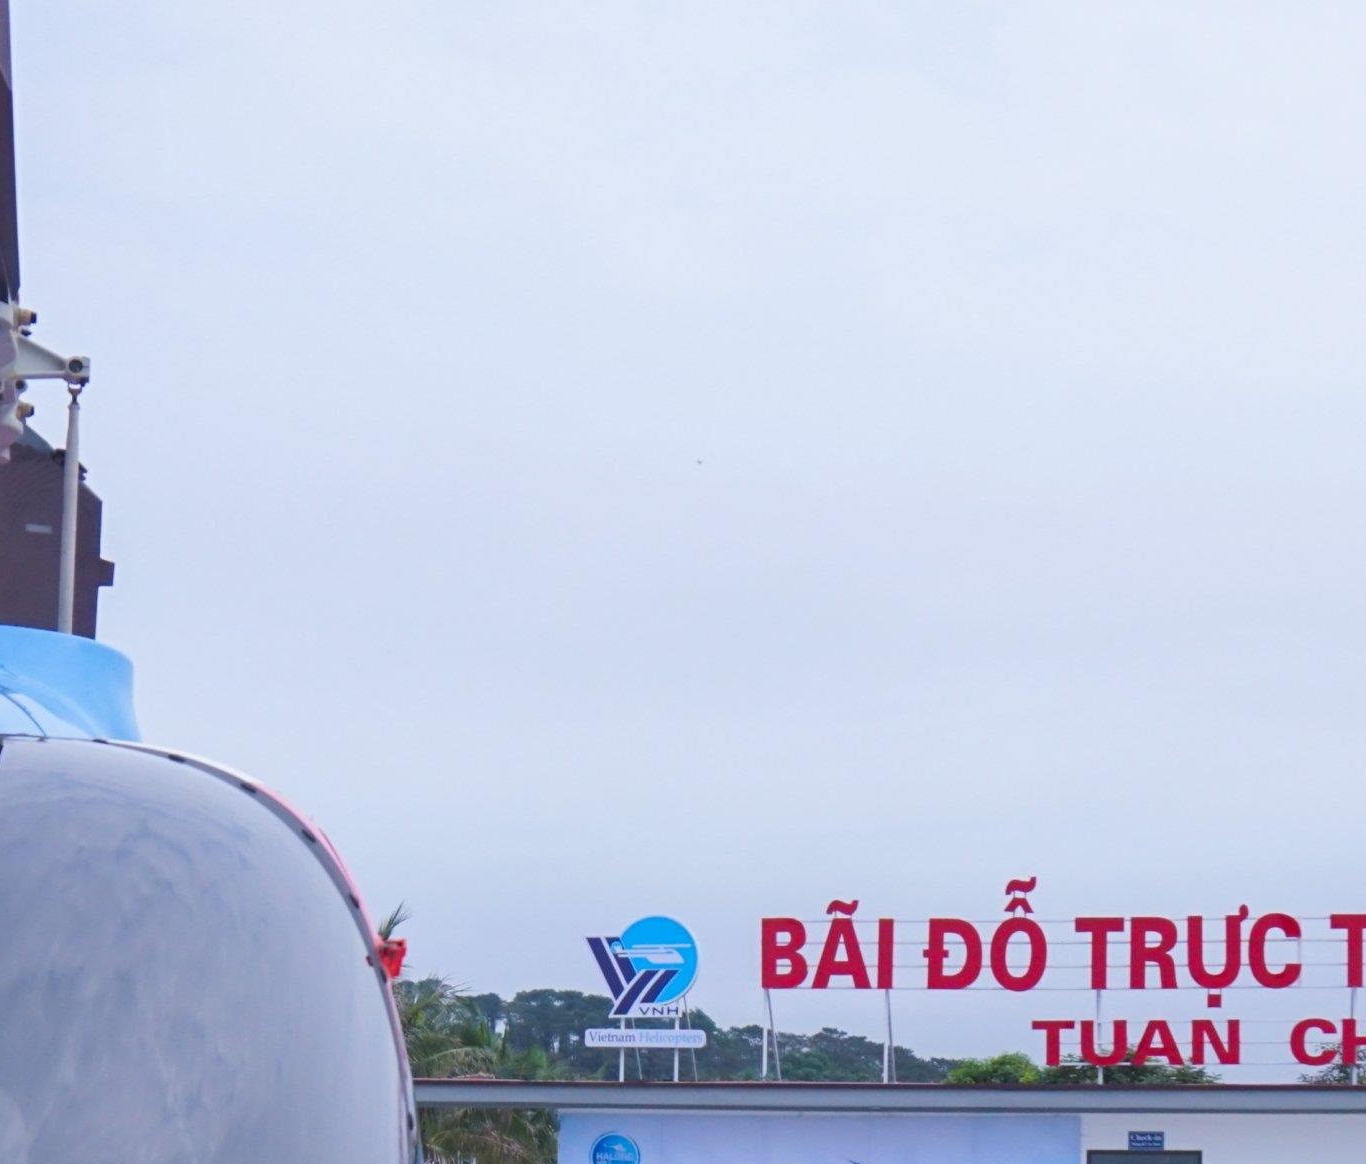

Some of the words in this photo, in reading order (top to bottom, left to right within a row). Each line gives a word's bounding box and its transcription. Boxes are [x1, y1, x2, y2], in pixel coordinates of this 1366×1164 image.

[761, 899, 894, 989] BÃI
[923, 876, 1048, 991] ĐỖ
[1075, 905, 1302, 1008] TRỰC
[638, 1006, 679, 1016] VNH
[588, 1031, 636, 1043] Vietnam
[638, 1032, 703, 1046] Helicopters
[1032, 1019, 1241, 1068] TUAN
